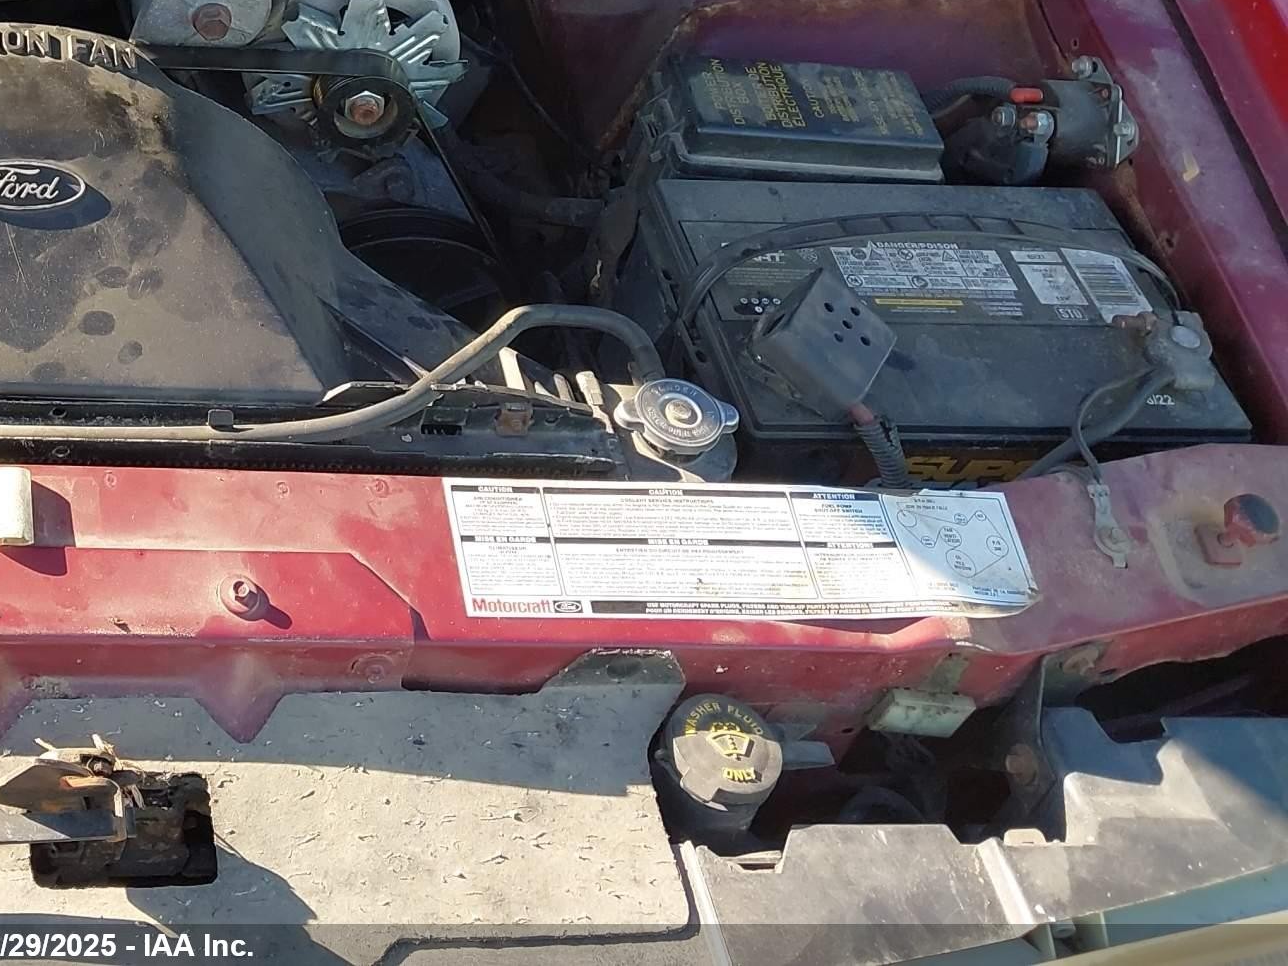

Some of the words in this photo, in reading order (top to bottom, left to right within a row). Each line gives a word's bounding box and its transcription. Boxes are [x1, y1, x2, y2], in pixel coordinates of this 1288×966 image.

[67, 35, 139, 72] FAN
[703, 71, 727, 111] POWER
[710, 58, 746, 125] DISTRIBUTION
[757, 62, 793, 128] DISTRIBUTION
[471, 597, 552, 613] Motorcraft
[685, 701, 720, 736] WASHER
[727, 705, 764, 735] FLUID
[722, 766, 757, 781] ONLY
